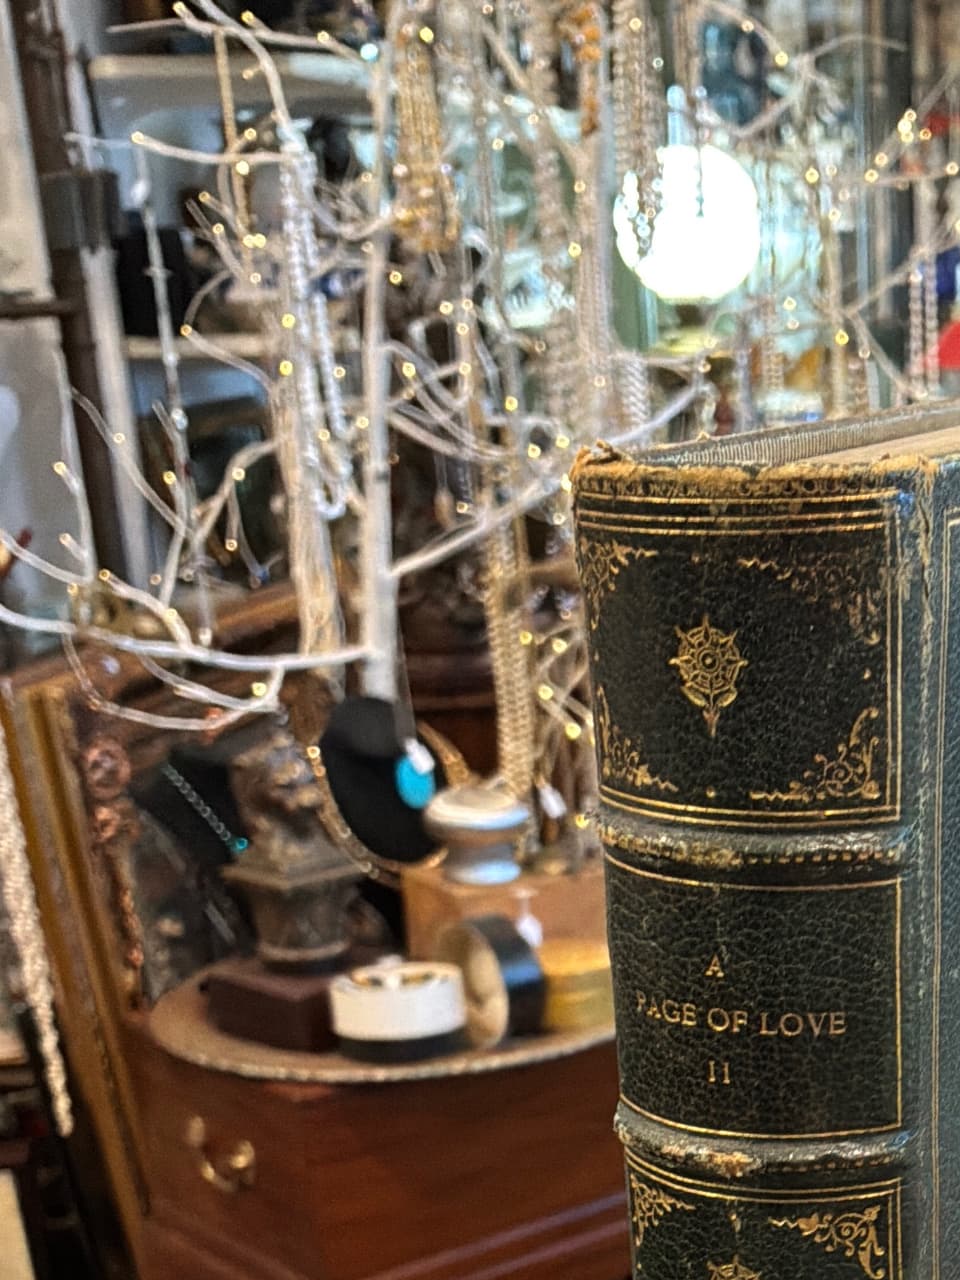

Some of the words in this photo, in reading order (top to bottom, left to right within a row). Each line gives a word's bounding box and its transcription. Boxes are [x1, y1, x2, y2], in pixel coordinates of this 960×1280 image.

[705, 954, 724, 977] A
[635, 990, 697, 1026] PAGE
[707, 1007, 748, 1033] OF
[759, 1011, 847, 1037] LOVE
[707, 1060, 731, 1084] II
